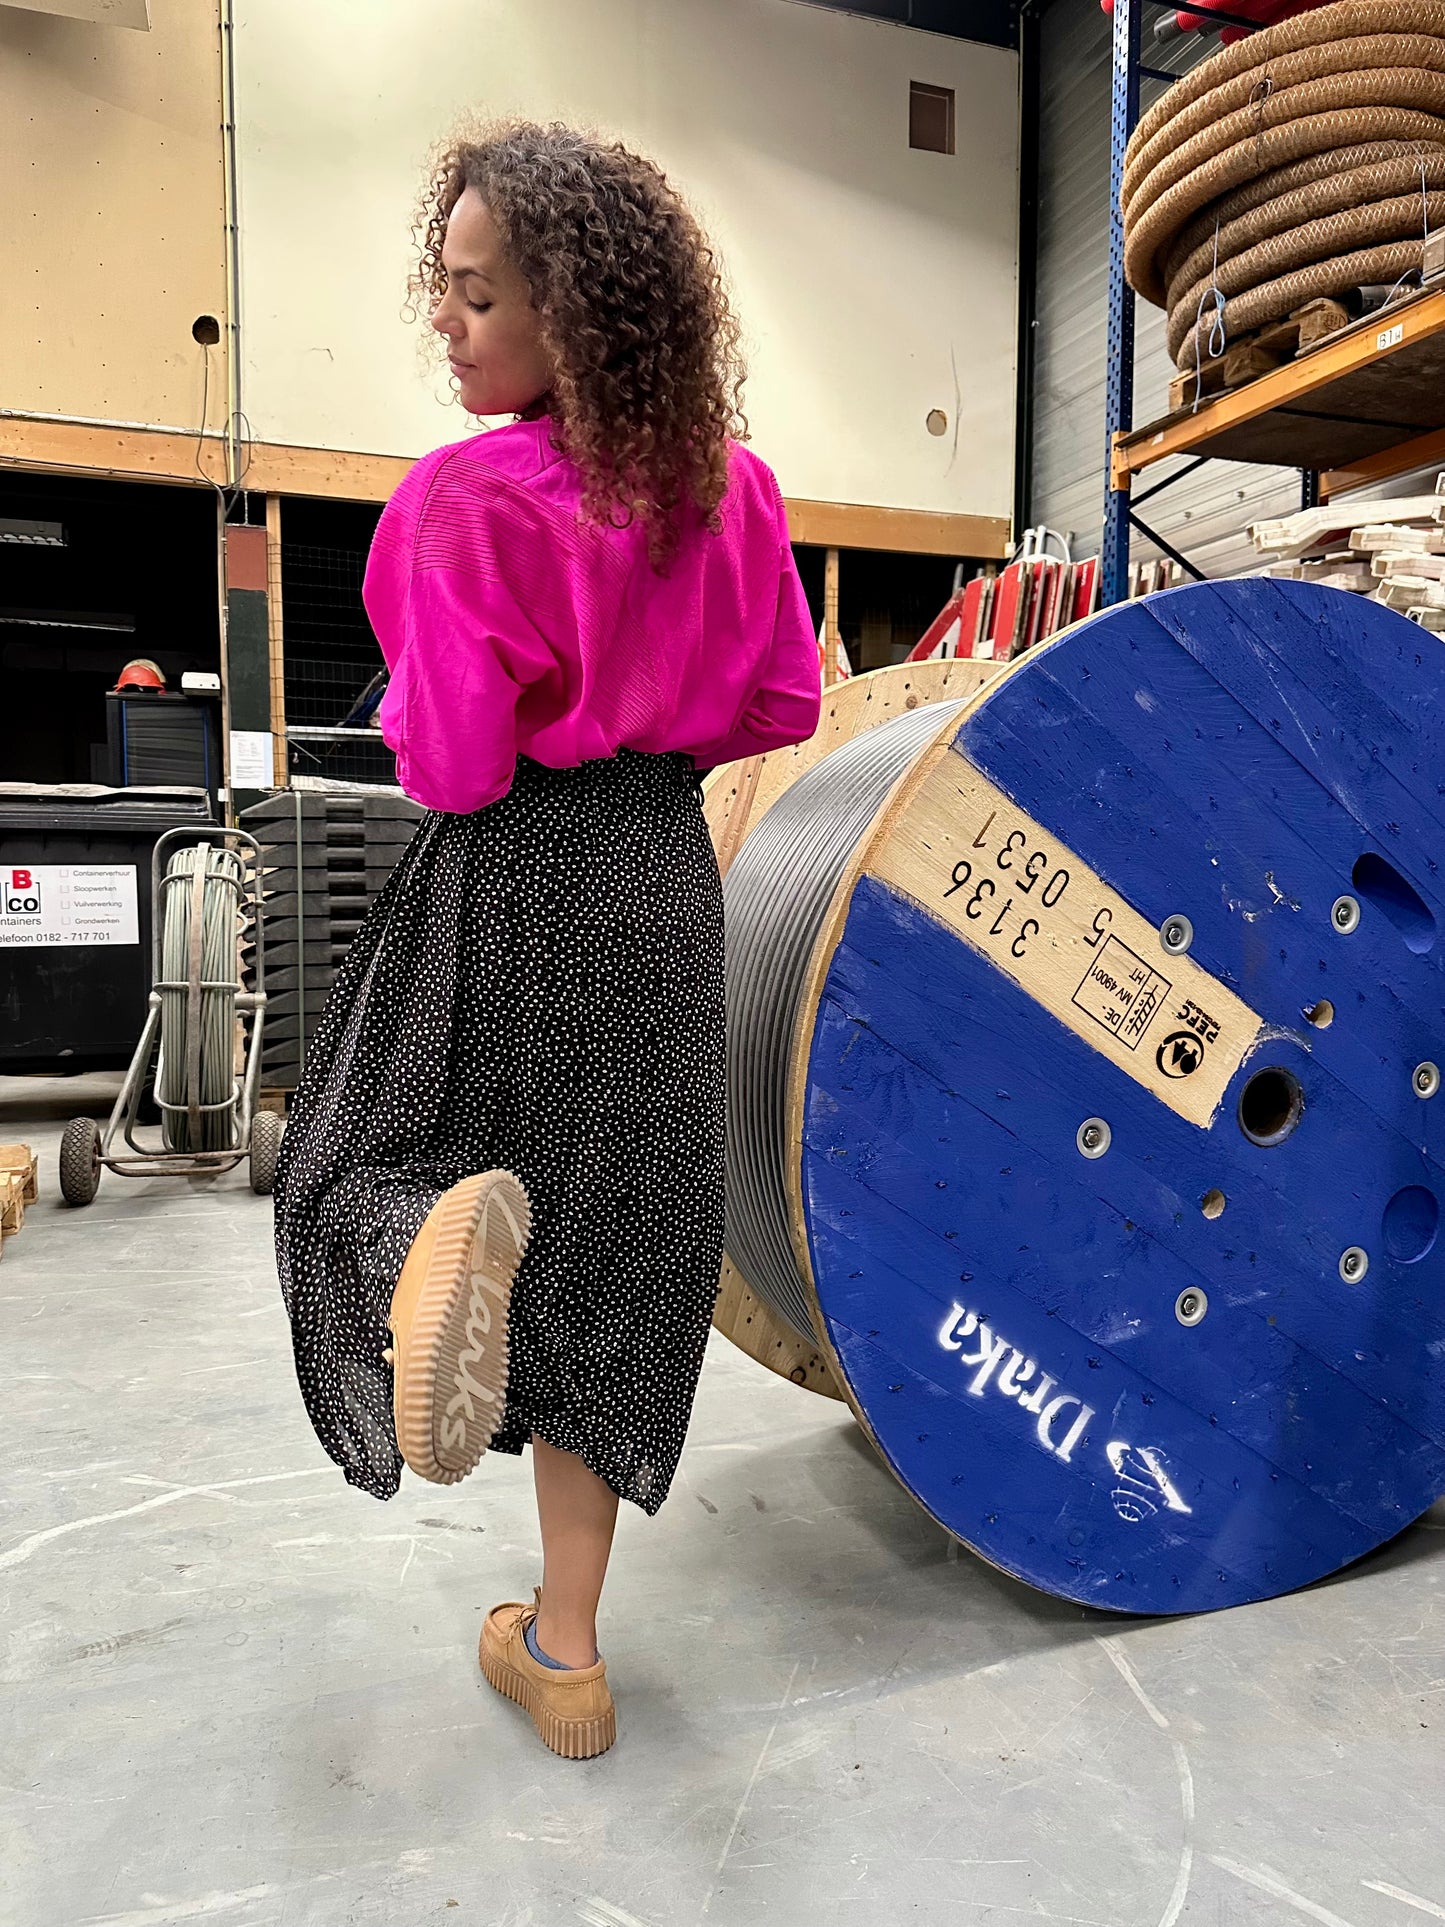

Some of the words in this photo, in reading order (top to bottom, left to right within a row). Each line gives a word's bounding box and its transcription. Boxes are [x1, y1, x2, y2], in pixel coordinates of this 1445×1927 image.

[972, 811, 1070, 908] 0531
[12, 869, 33, 889] B
[73, 885, 117, 893] Sloopwerken
[8, 897, 39, 912] co
[943, 860, 1040, 958] 3136
[36, 933, 62, 942] 0182
[71, 932, 89, 941] 717
[92, 932, 111, 941] 701
[1083, 907, 1113, 948] 5
[1091, 966, 1118, 992] 49001
[1129, 967, 1146, 986] HT
[1115, 987, 1134, 1006] MV
[1176, 1004, 1220, 1044] PEFC
[937, 1300, 1097, 1464] Draka
